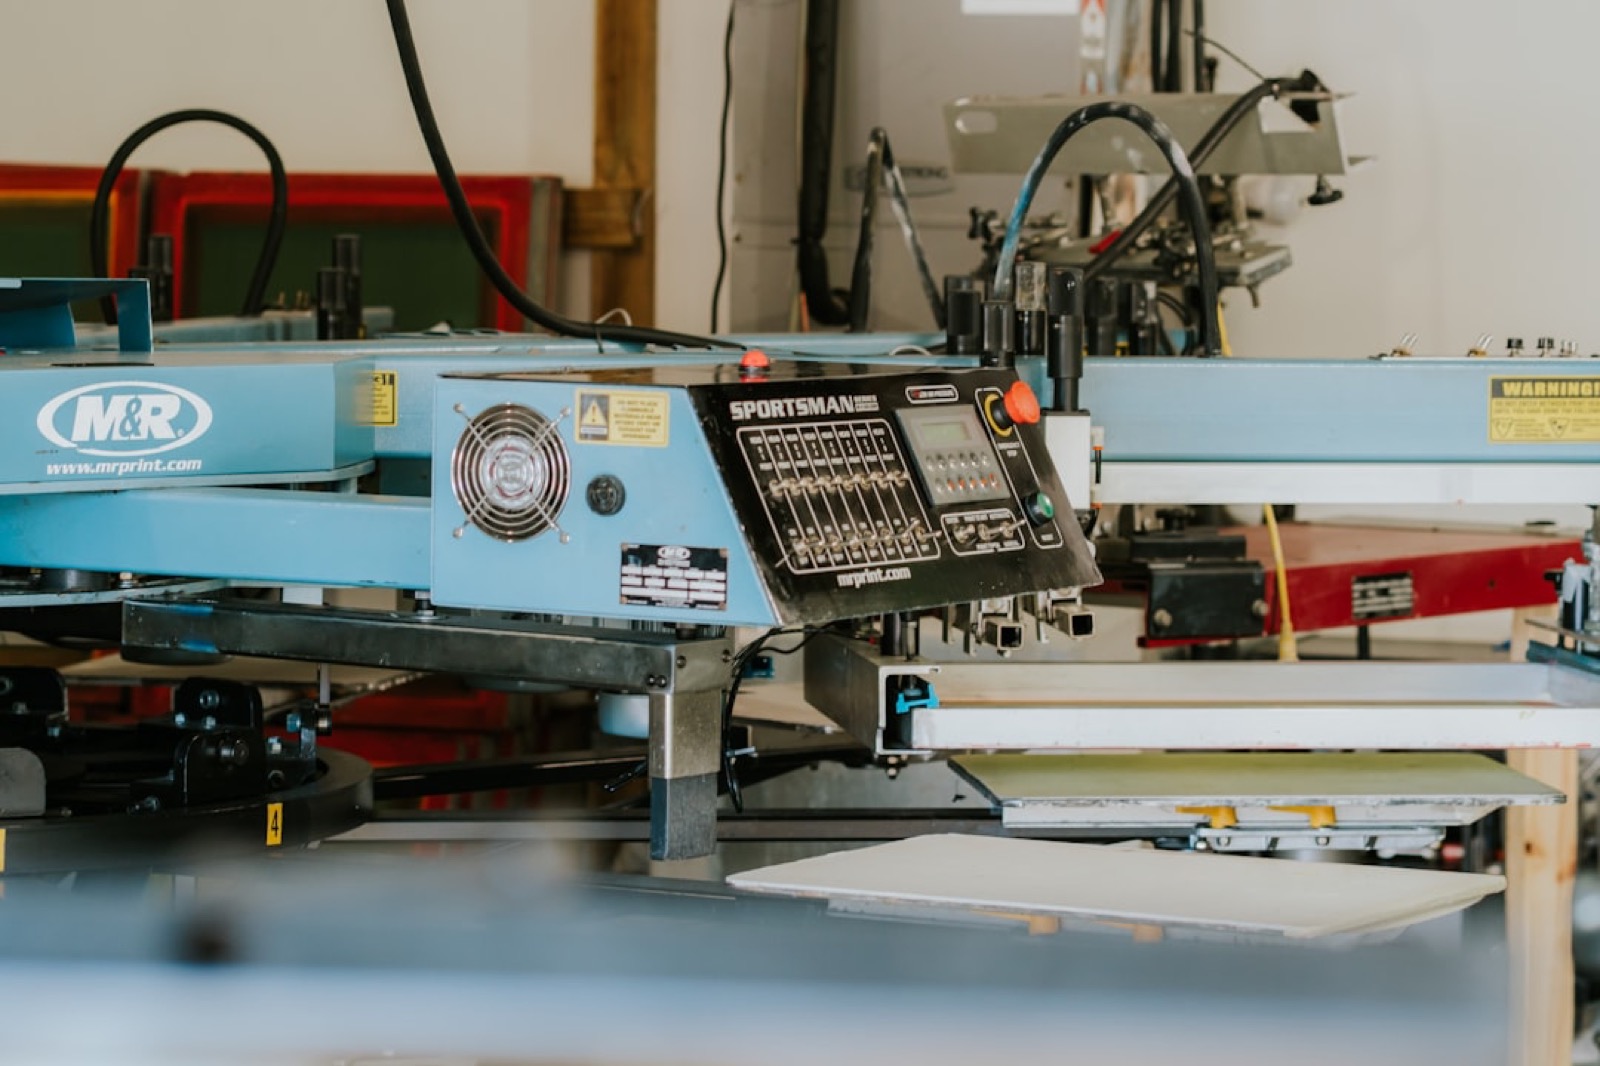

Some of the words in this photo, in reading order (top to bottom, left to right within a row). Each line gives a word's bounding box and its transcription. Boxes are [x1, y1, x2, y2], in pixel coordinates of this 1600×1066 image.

[729, 394, 854, 420] SPORTSMAN
[46, 458, 203, 476] www.mrprint.com
[836, 567, 912, 589] mrprint.com
[270, 808, 280, 839] 4
